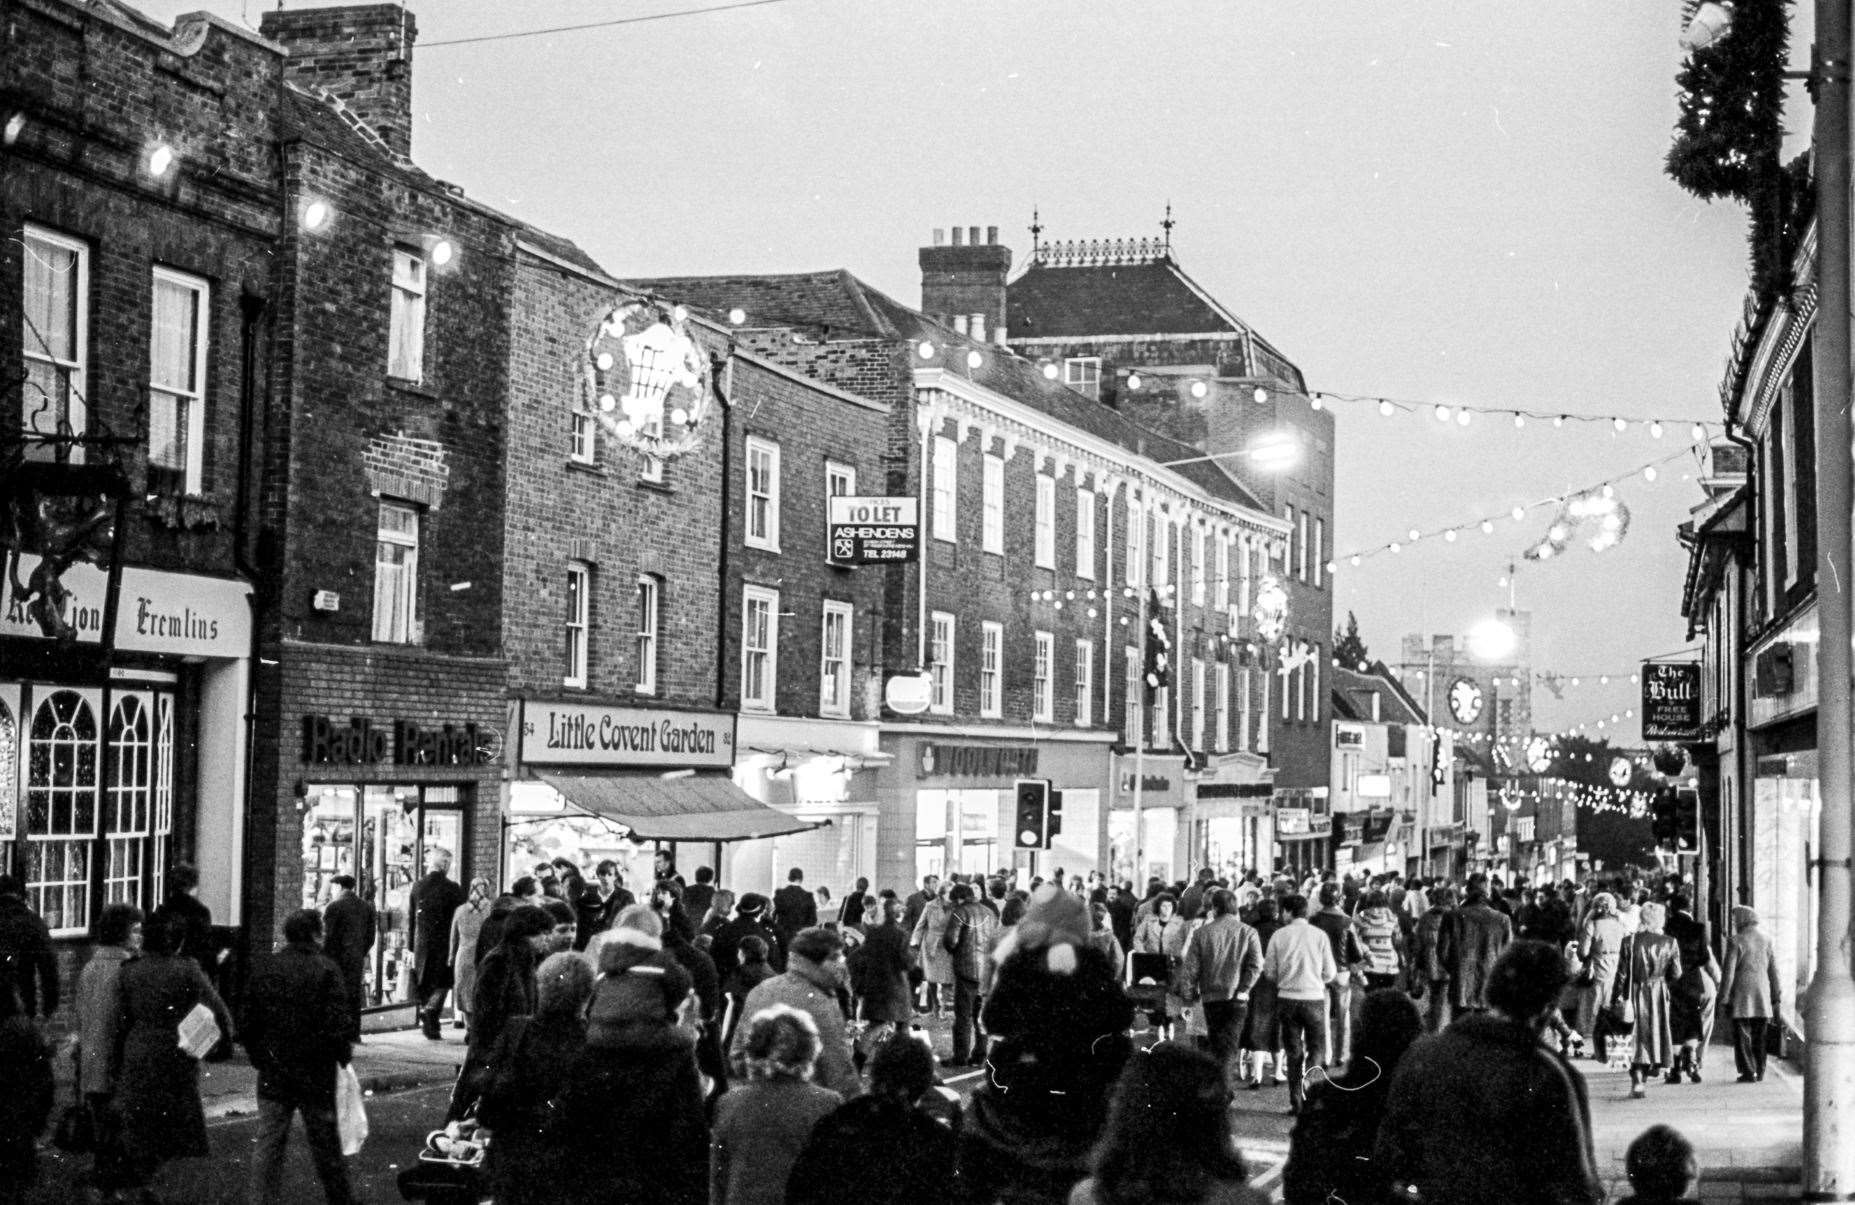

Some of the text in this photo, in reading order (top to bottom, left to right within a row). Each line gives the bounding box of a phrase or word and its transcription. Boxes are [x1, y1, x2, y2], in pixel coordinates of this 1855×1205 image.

[848, 506, 901, 522] TO LET
[834, 527, 915, 539] ASHENDENS
[863, 549, 879, 559] TEL
[136, 597, 219, 640] Fremlins
[1658, 666, 1684, 679] The
[1648, 681, 1691, 700] Bull
[1657, 706, 1687, 714] FREE
[1652, 714, 1691, 722] HOUSE
[547, 711, 715, 753] Little Covent Garden
[303, 716, 491, 765] Radio Rentals
